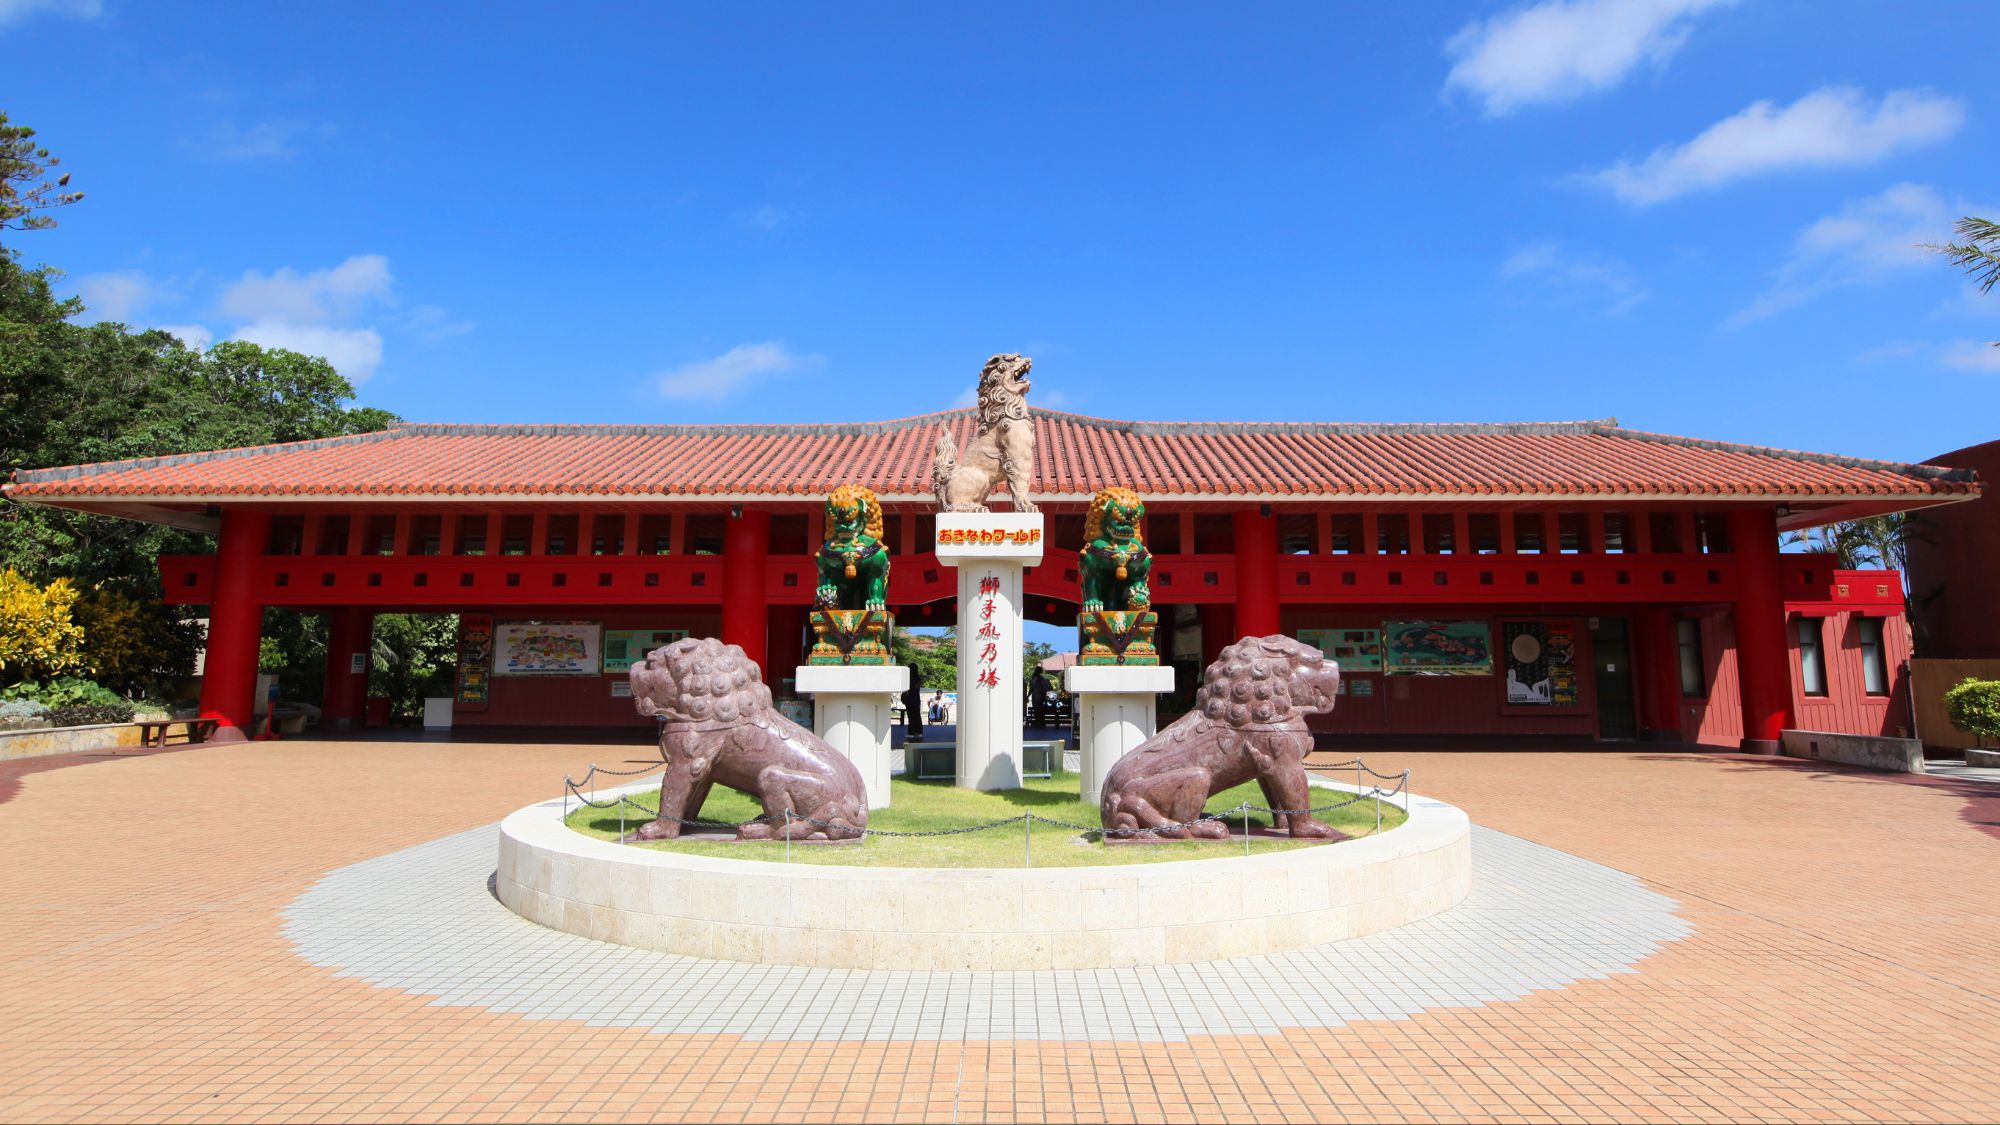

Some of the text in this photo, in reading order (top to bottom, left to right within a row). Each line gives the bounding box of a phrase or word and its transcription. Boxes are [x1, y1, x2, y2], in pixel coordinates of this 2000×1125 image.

[938, 528, 1041, 543] おきなわワールド
